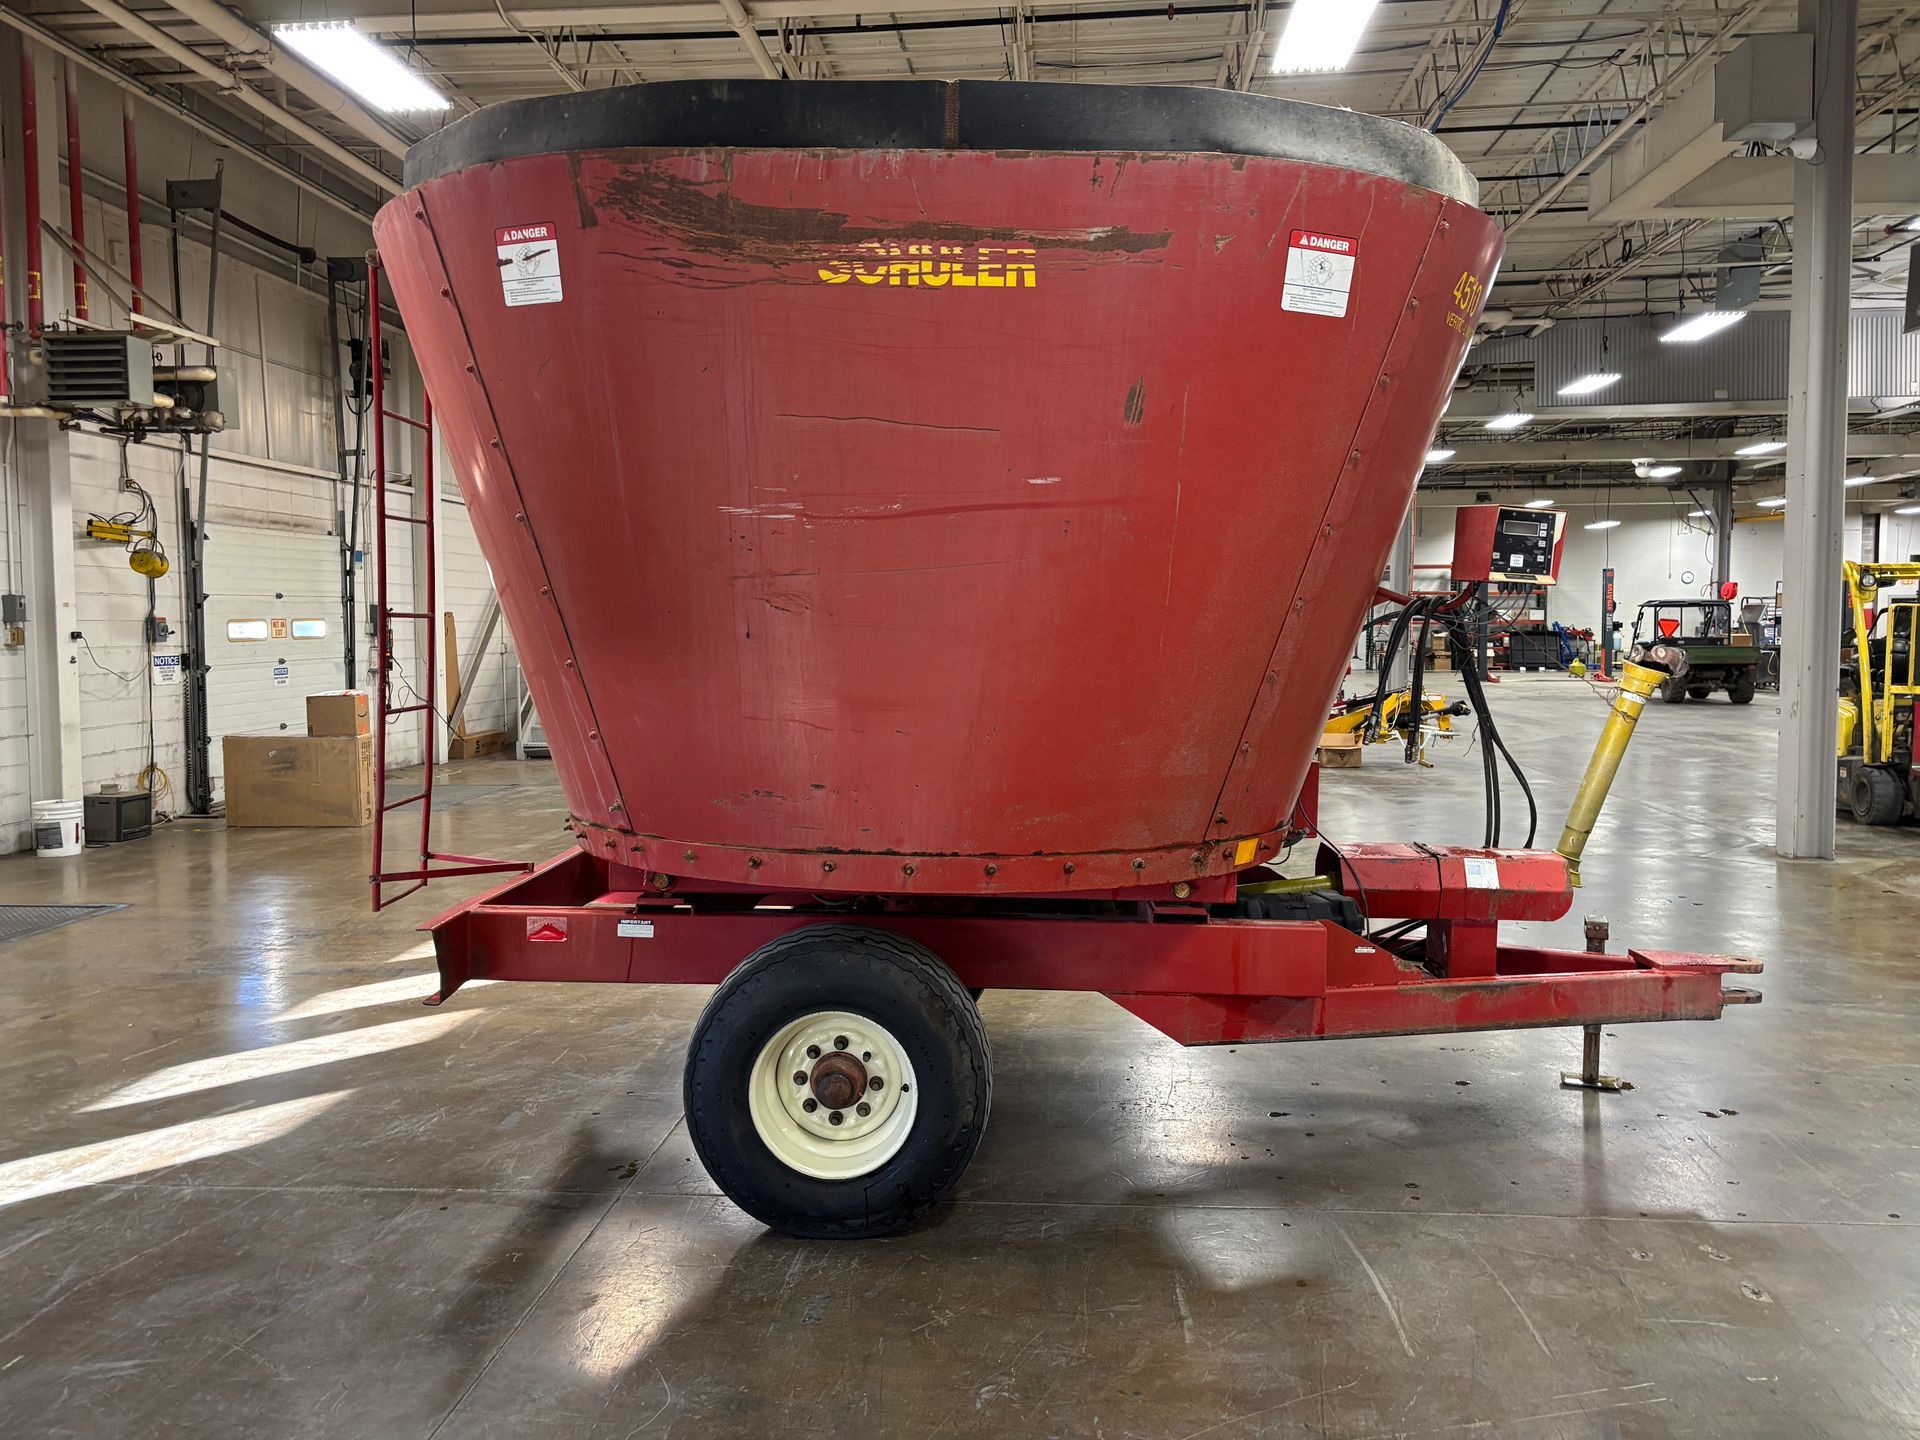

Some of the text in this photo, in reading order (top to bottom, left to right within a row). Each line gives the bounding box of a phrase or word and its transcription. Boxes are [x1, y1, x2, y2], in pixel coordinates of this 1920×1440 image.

[511, 227, 548, 240] DANGER
[1310, 236, 1350, 252] DANGER
[1453, 271, 1483, 318] 4510
[154, 656, 179, 666] NOTICE
